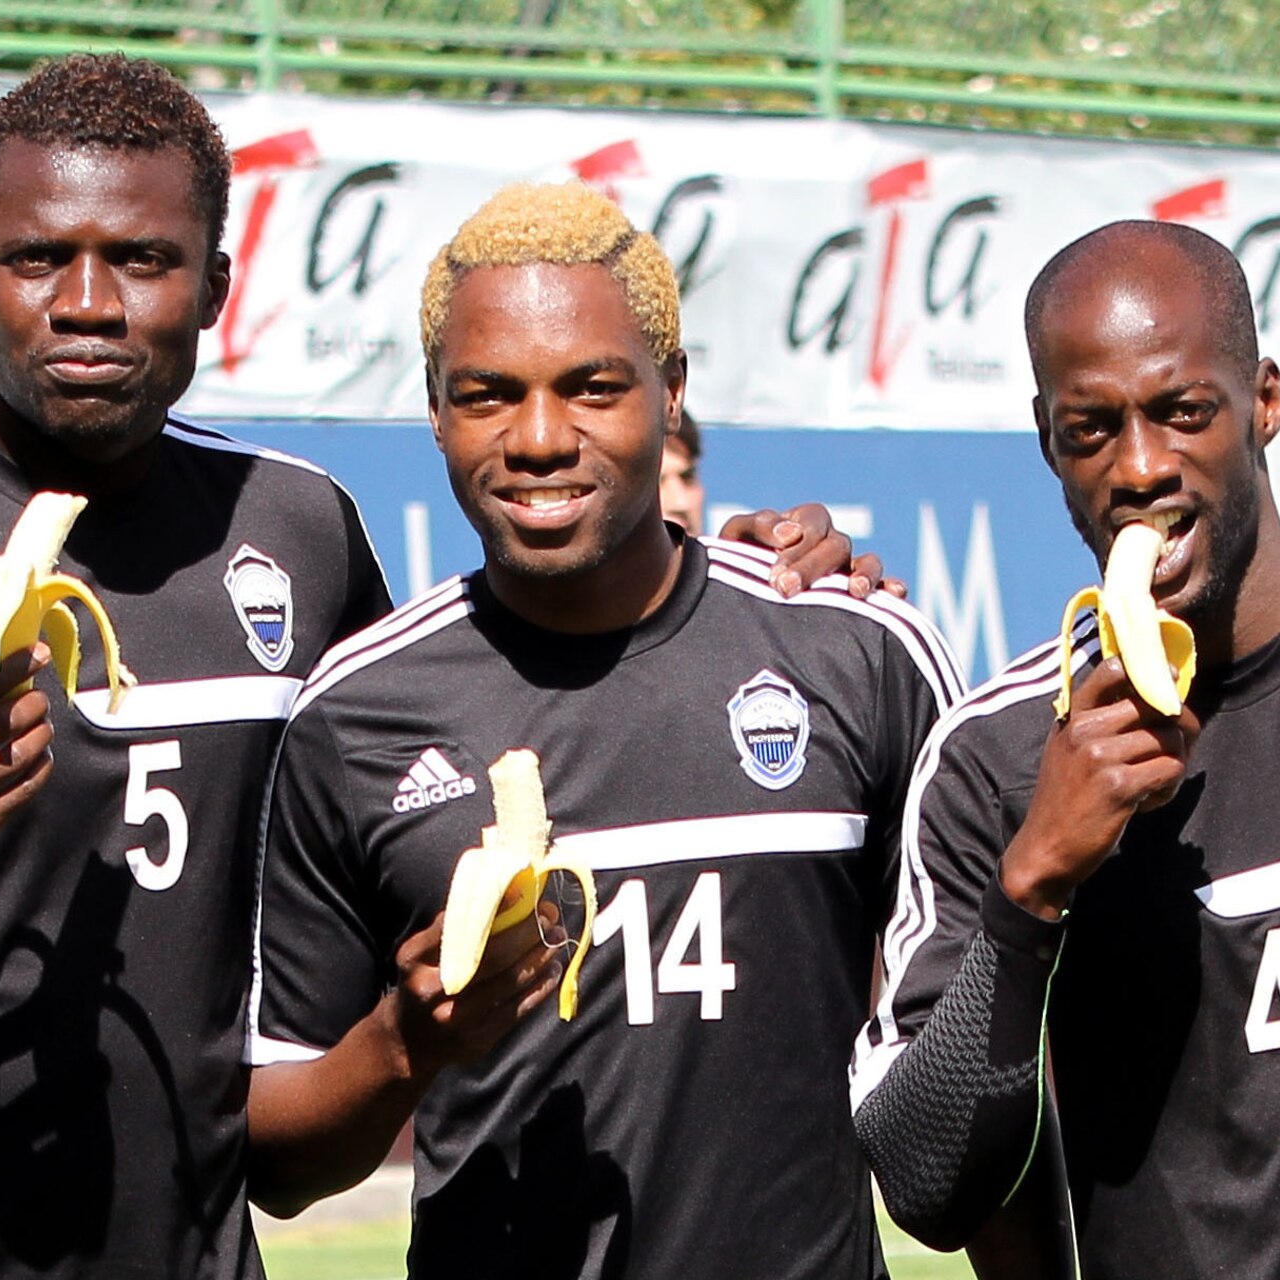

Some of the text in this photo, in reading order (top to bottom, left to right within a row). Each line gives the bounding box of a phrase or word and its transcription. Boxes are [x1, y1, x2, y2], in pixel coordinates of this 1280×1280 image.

[124, 740, 189, 892] 5
[392, 775, 476, 813] adidas
[592, 871, 736, 1026] 14
